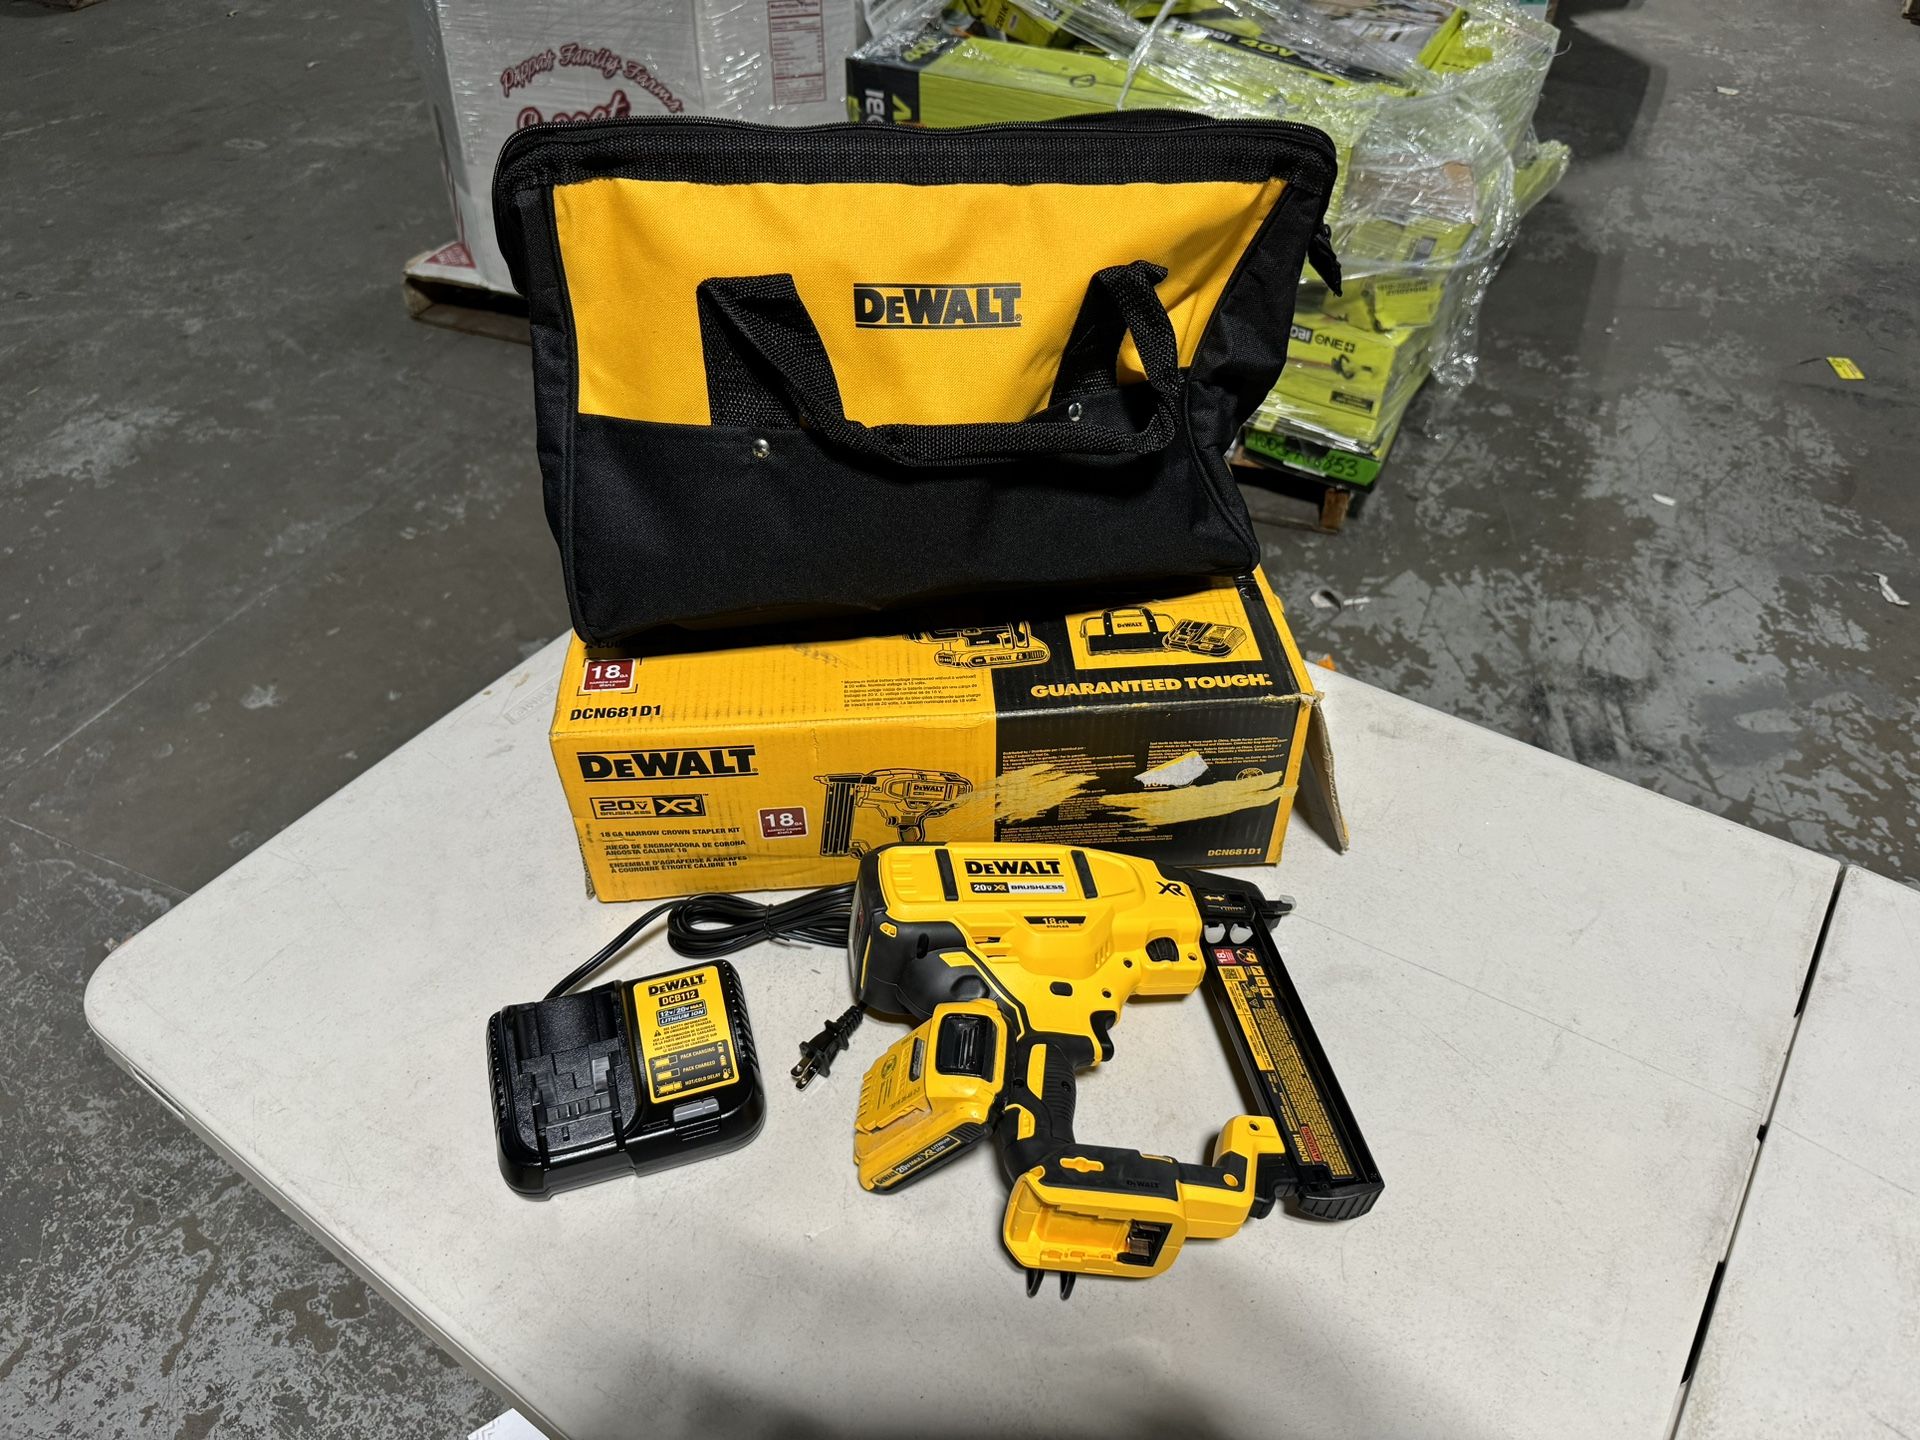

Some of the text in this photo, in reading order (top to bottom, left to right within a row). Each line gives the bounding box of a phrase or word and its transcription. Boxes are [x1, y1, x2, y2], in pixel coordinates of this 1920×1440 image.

[558, 43, 622, 80] Family
[854, 288, 1021, 324] DEWALT
[591, 665, 621, 679] 18
[1030, 678, 1183, 698] GUARANTEED
[570, 704, 661, 721] DCN681D1
[578, 748, 756, 778] DEWALT
[913, 784, 944, 792] DEWALT
[657, 797, 700, 814] XR
[765, 813, 795, 827] 18
[1207, 848, 1261, 856] DCN681D1
[964, 861, 1060, 874] DEWALT
[1156, 881, 1186, 897] XR
[648, 974, 704, 995] DEWALT
[662, 990, 696, 1005] DCB112
[661, 1009, 704, 1024] LITHIUM ION
[692, 1047, 716, 1057] CHARGING
[695, 1060, 716, 1069] CHARGED
[707, 1072, 721, 1080] DELAY
